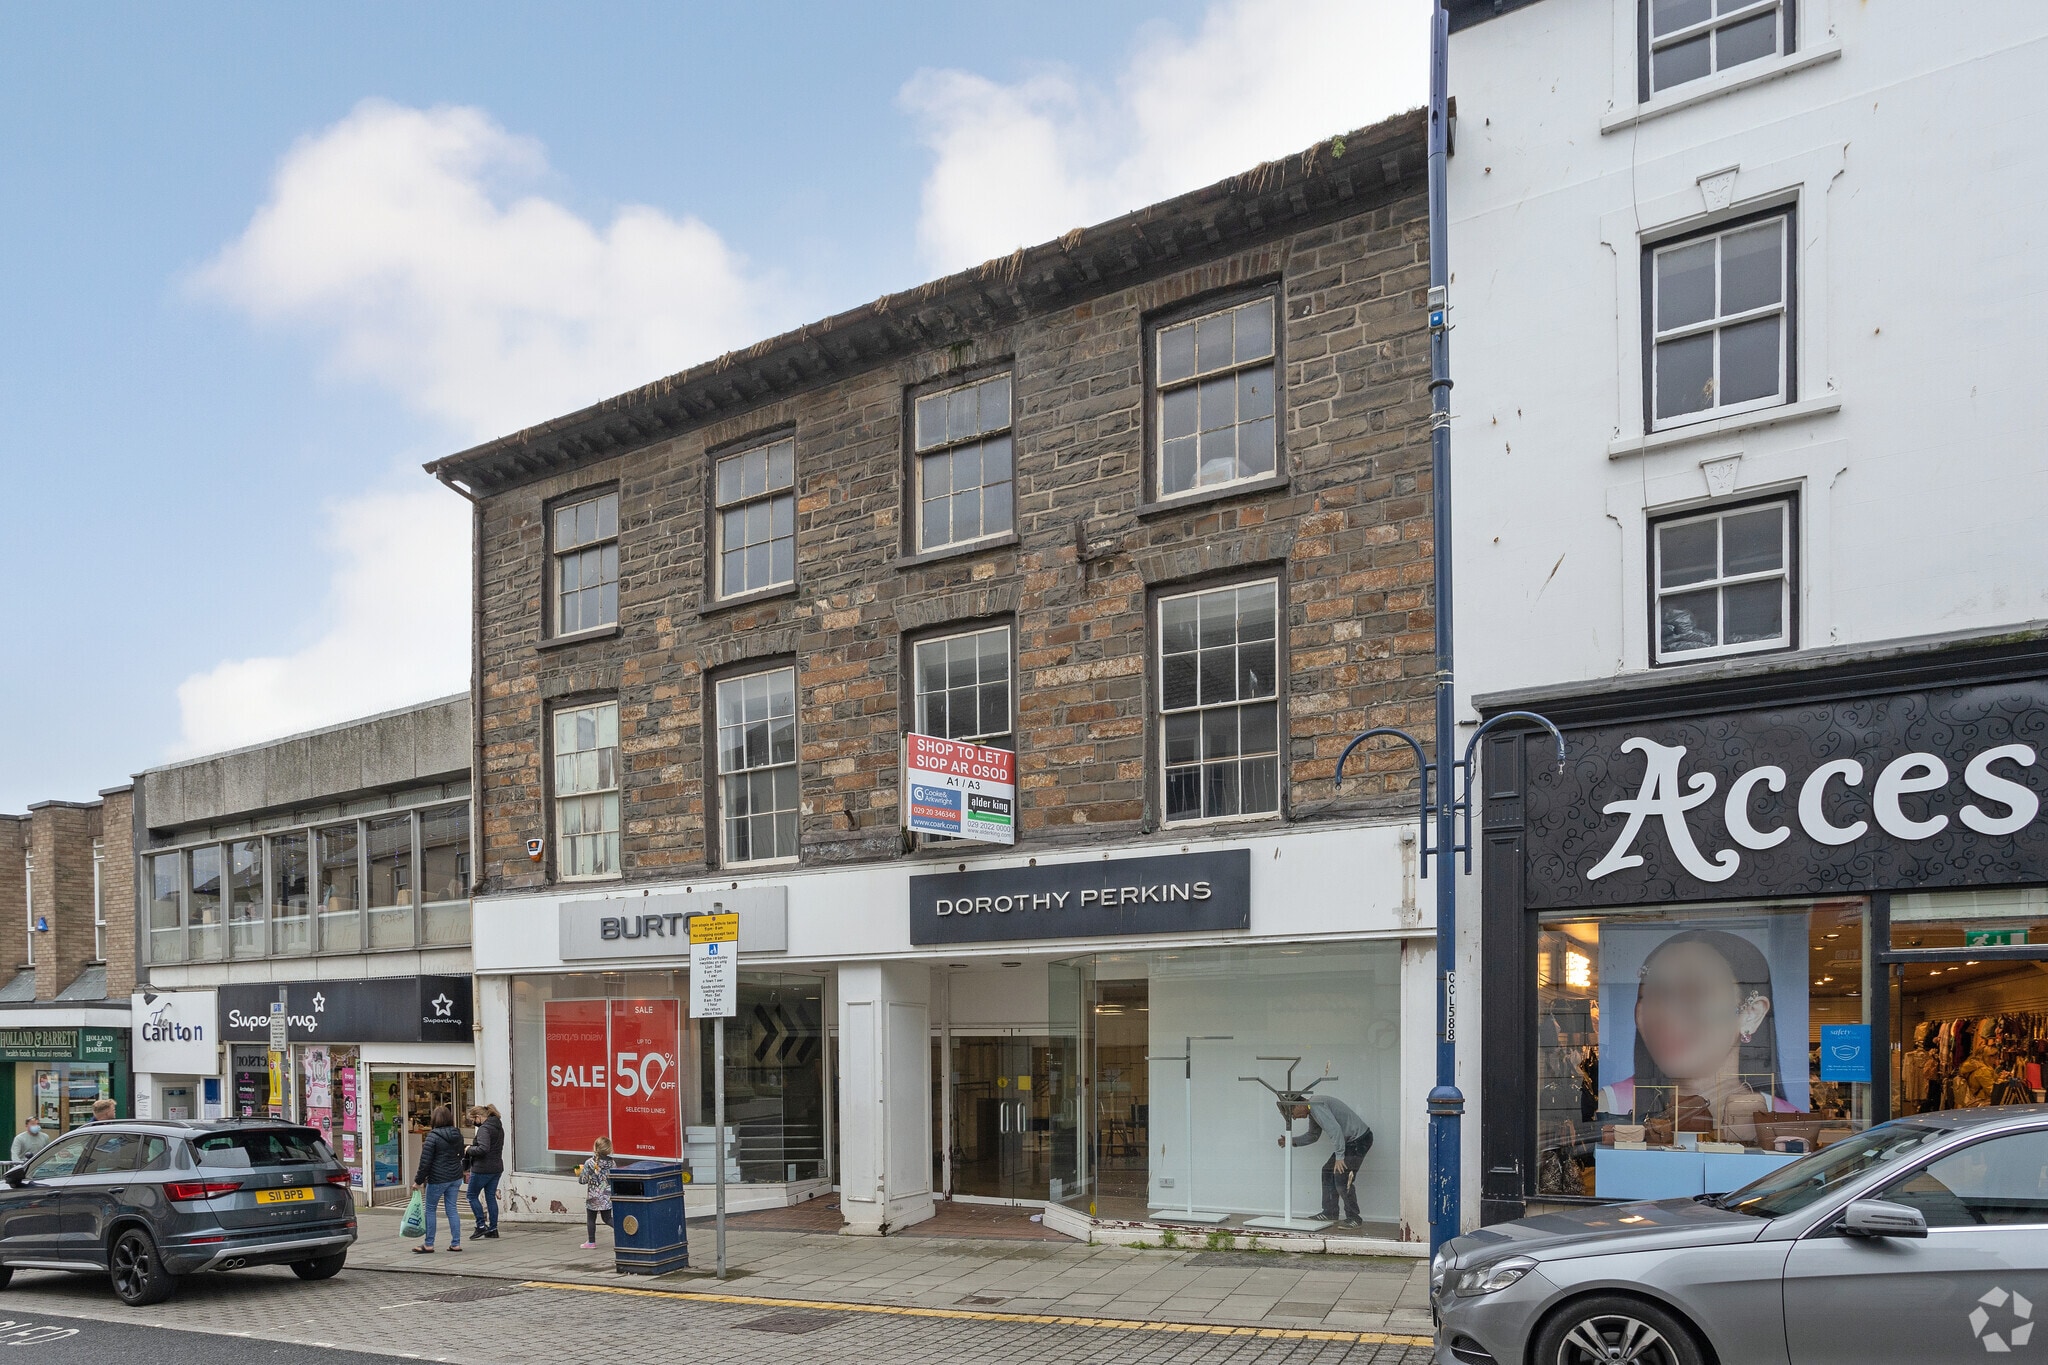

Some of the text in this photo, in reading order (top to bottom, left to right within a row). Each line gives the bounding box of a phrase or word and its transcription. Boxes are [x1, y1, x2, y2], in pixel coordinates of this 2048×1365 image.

[917, 739, 1008, 767] SHOP TO LET /
[916, 755, 1008, 780] SIOP AR OSOD
[946, 777, 959, 787] A1
[967, 780, 981, 790] A3
[924, 796, 953, 806] Arkwright
[971, 796, 1008, 813] alder king
[913, 807, 926, 815] 029
[934, 810, 956, 819] 346346
[1586, 736, 2040, 883] Acces
[913, 819, 959, 831] www.coark.com
[967, 820, 1011, 833] 029 2022 0000
[936, 881, 1212, 917] DOROTHY PERKINS
[634, 1006, 653, 1014] SALE
[228, 1009, 318, 1032] Superug
[422, 1016, 462, 1025] Superdrug
[0, 1030, 78, 1048] HOLLAND & BARRETT
[142, 1021, 203, 1042] Carlton
[550, 1065, 606, 1087] SALE
[614, 1052, 675, 1102] 50%
[660, 1082, 676, 1090] OFF
[345, 1100, 354, 1110] 30
[283, 1189, 304, 1200] BPB
